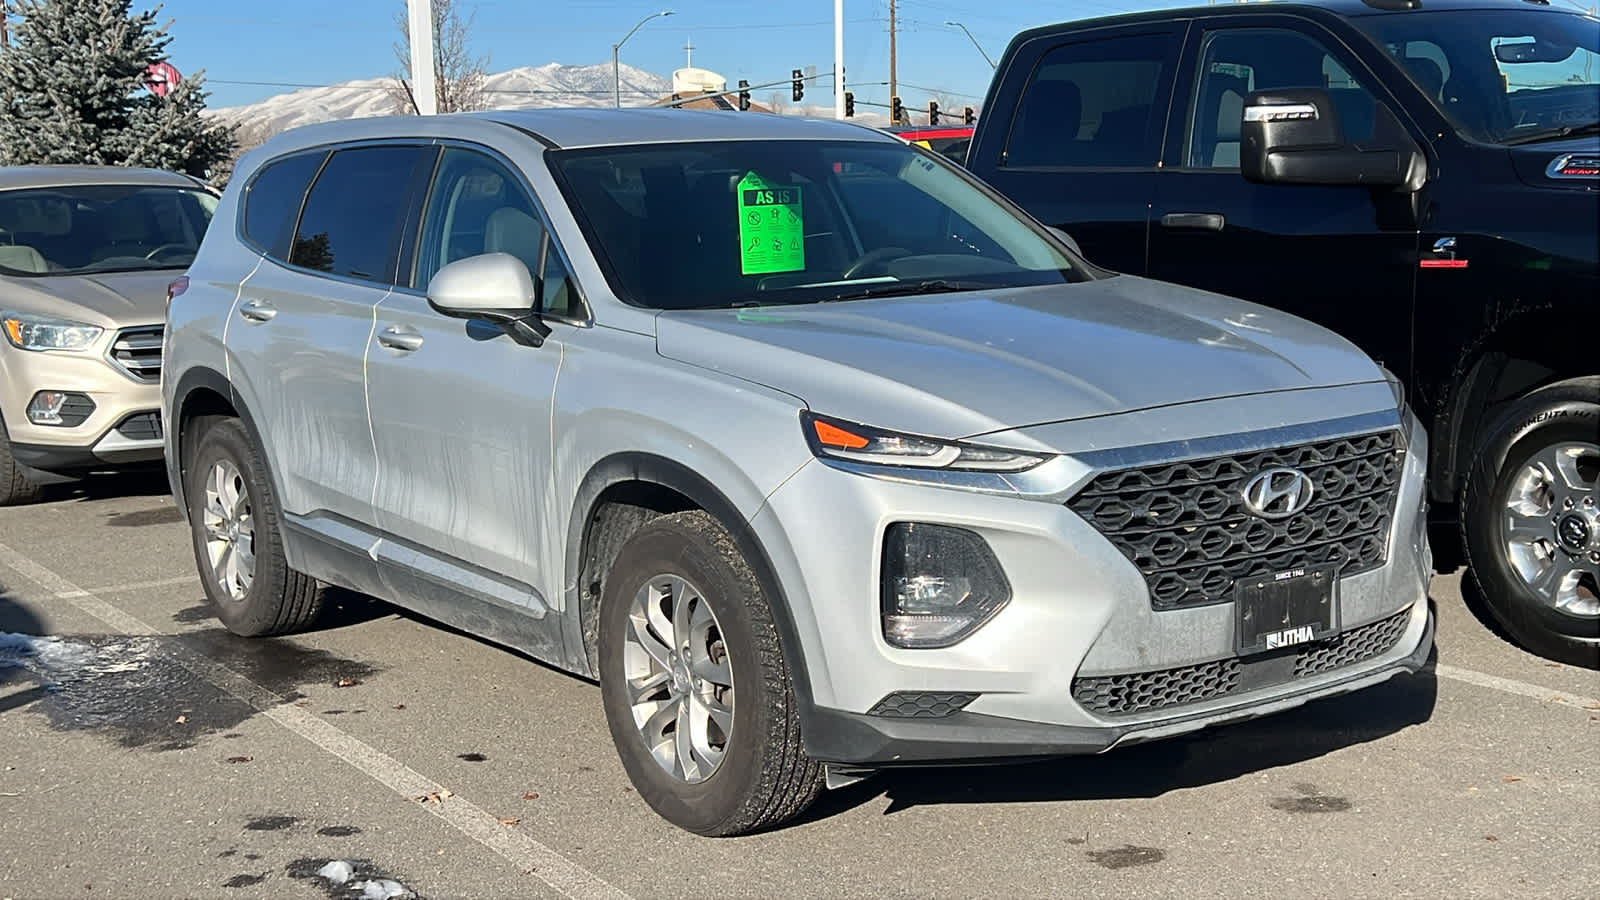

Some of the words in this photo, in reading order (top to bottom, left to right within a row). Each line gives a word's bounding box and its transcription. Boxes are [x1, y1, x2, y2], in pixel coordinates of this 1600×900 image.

[756, 191, 774, 204] AS
[778, 190, 791, 204] IS
[1277, 625, 1314, 647] LITHIA
